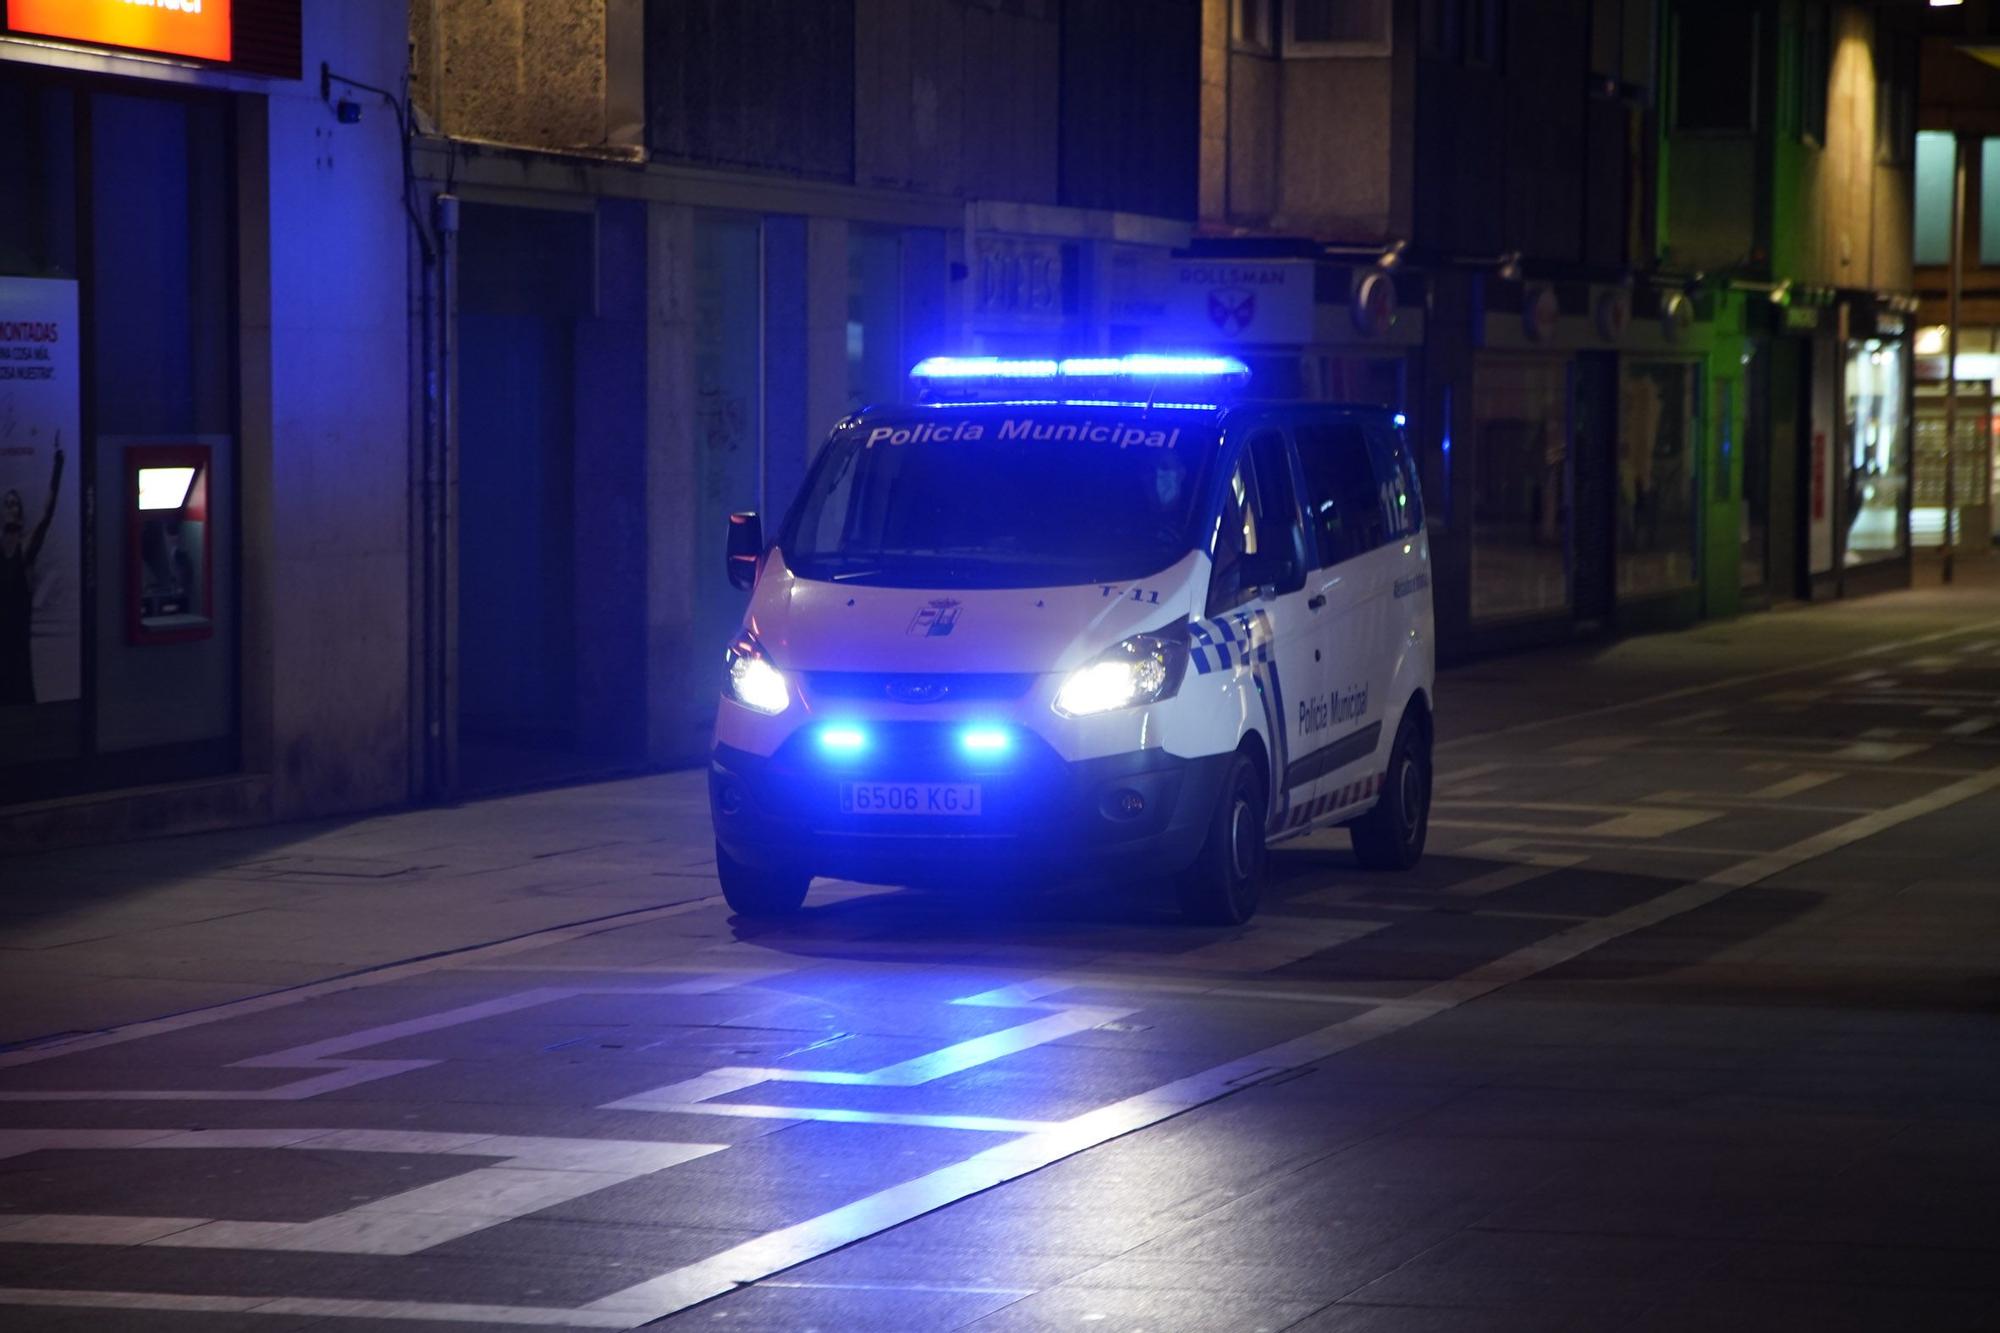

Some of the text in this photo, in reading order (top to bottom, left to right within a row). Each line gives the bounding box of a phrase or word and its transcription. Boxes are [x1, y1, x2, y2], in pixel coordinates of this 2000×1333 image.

[866, 419, 1180, 449] Policía Municipal
[1299, 681, 1369, 736] Policía Municipal
[857, 787, 918, 810] 6506
[928, 787, 974, 811] KGJ
